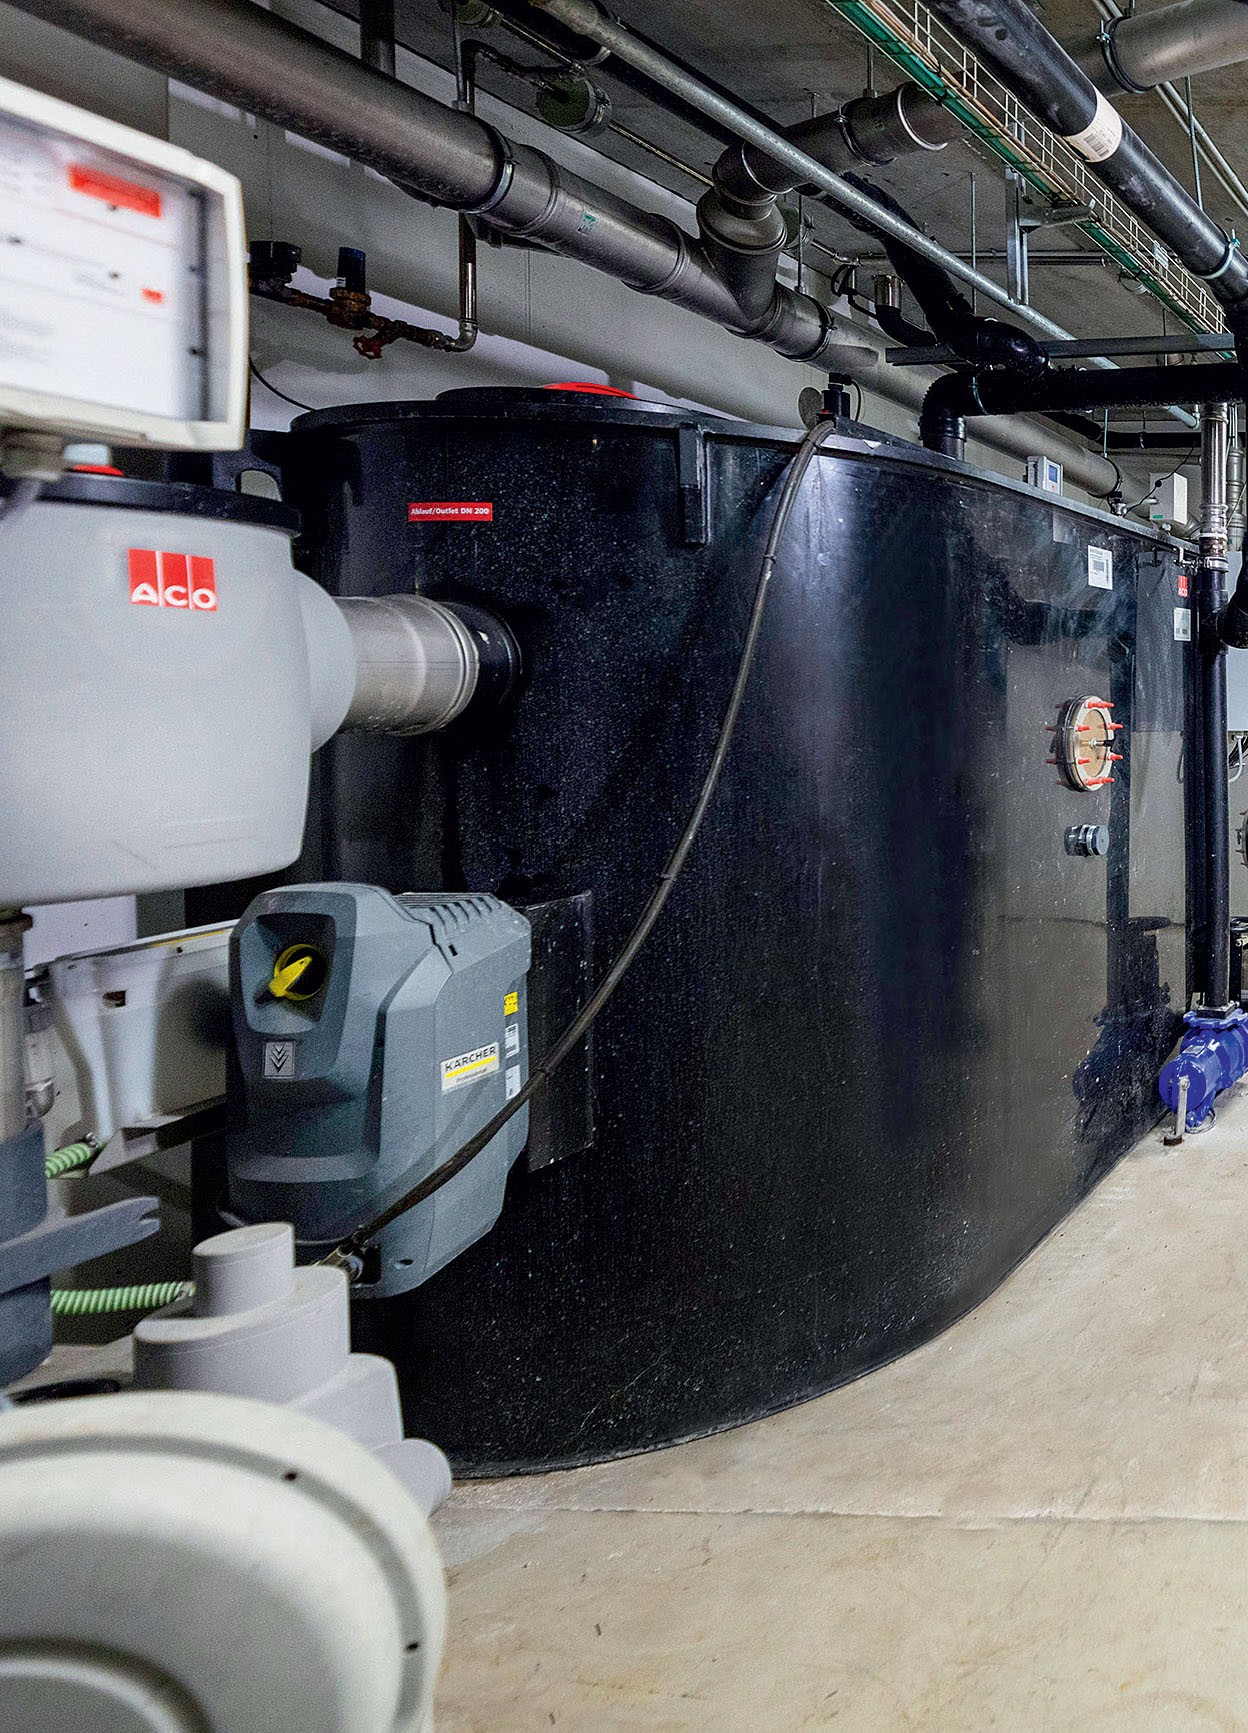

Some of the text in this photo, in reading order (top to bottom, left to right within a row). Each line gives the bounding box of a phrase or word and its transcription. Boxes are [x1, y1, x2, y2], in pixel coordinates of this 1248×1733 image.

[411, 507, 490, 515] Ablauf/Outlet DN 200
[132, 582, 216, 609] ACO
